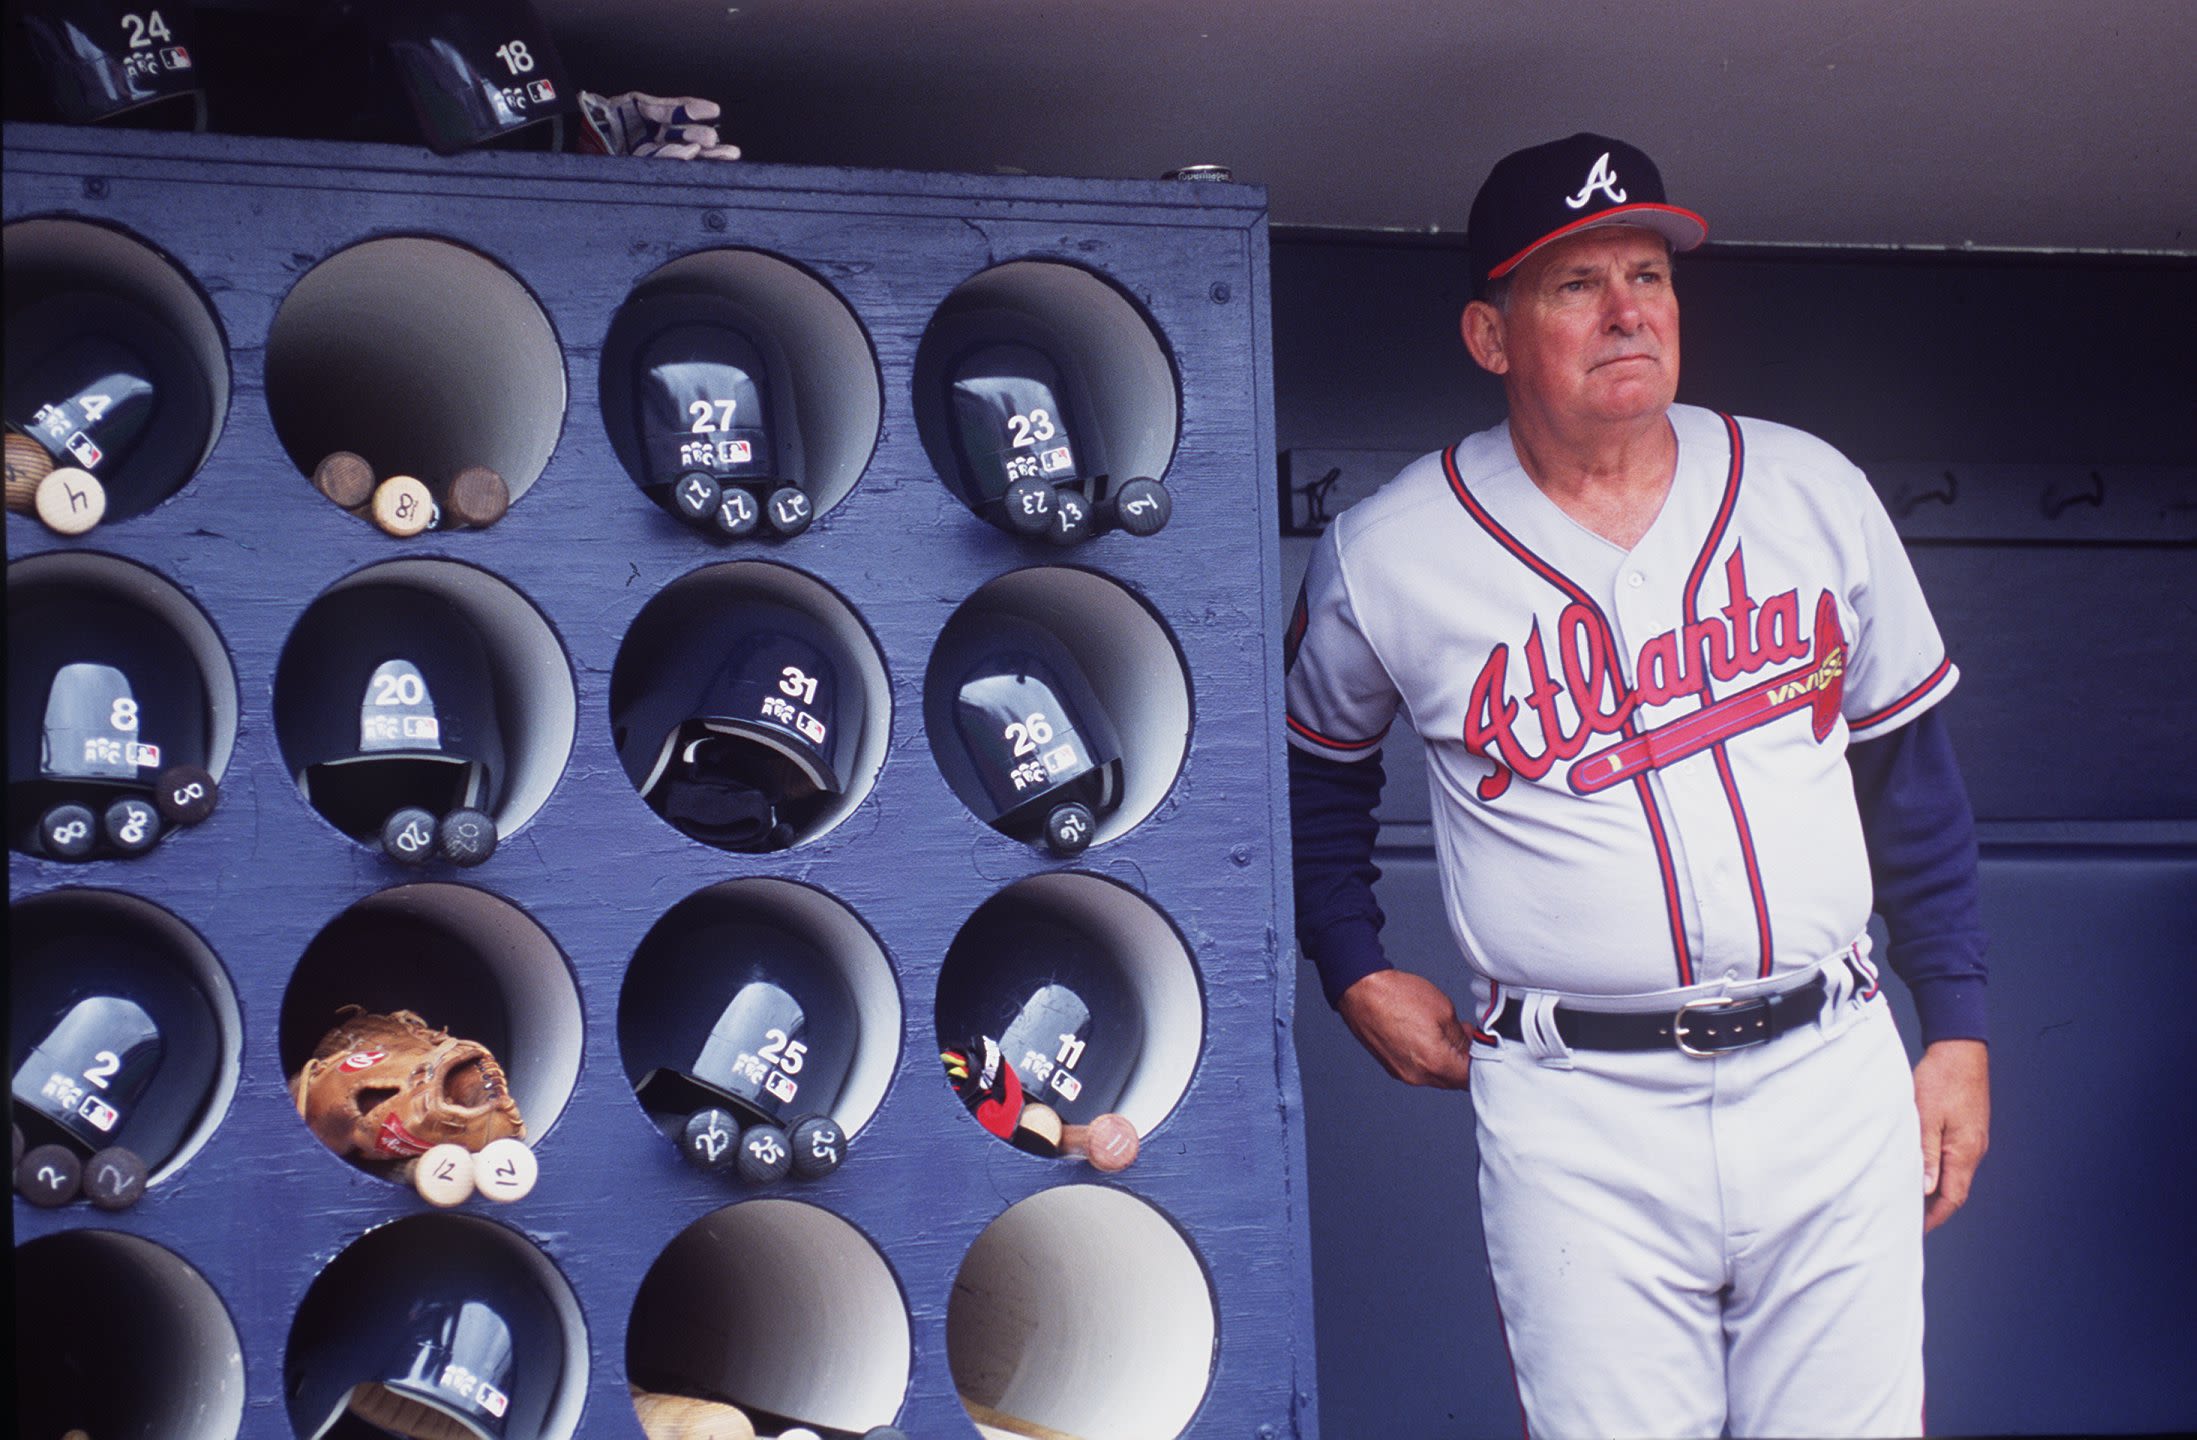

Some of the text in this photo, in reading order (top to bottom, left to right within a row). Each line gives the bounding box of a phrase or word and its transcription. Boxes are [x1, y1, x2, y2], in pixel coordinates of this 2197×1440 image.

[121, 10, 171, 48] 24
[495, 40, 534, 75] 18
[1565, 152, 1627, 208] A
[79, 395, 111, 421] 4
[688, 399, 737, 434] 27
[1007, 409, 1055, 448] 23
[395, 493, 413, 518] 8
[780, 667, 818, 705] 31
[1464, 536, 1811, 801] Atlanta
[373, 674, 423, 705] 20
[110, 698, 138, 731] 8
[1004, 712, 1053, 757] 26
[174, 783, 203, 805] 8
[53, 821, 87, 844] 8
[757, 1029, 808, 1074] 25
[1056, 1033, 1086, 1070] 11
[83, 1051, 120, 1089] 2
[38, 1166, 66, 1189] 2
[98, 1165, 135, 1195] 2
[432, 1158, 456, 1182] 12
[495, 1159, 519, 1186] 12
